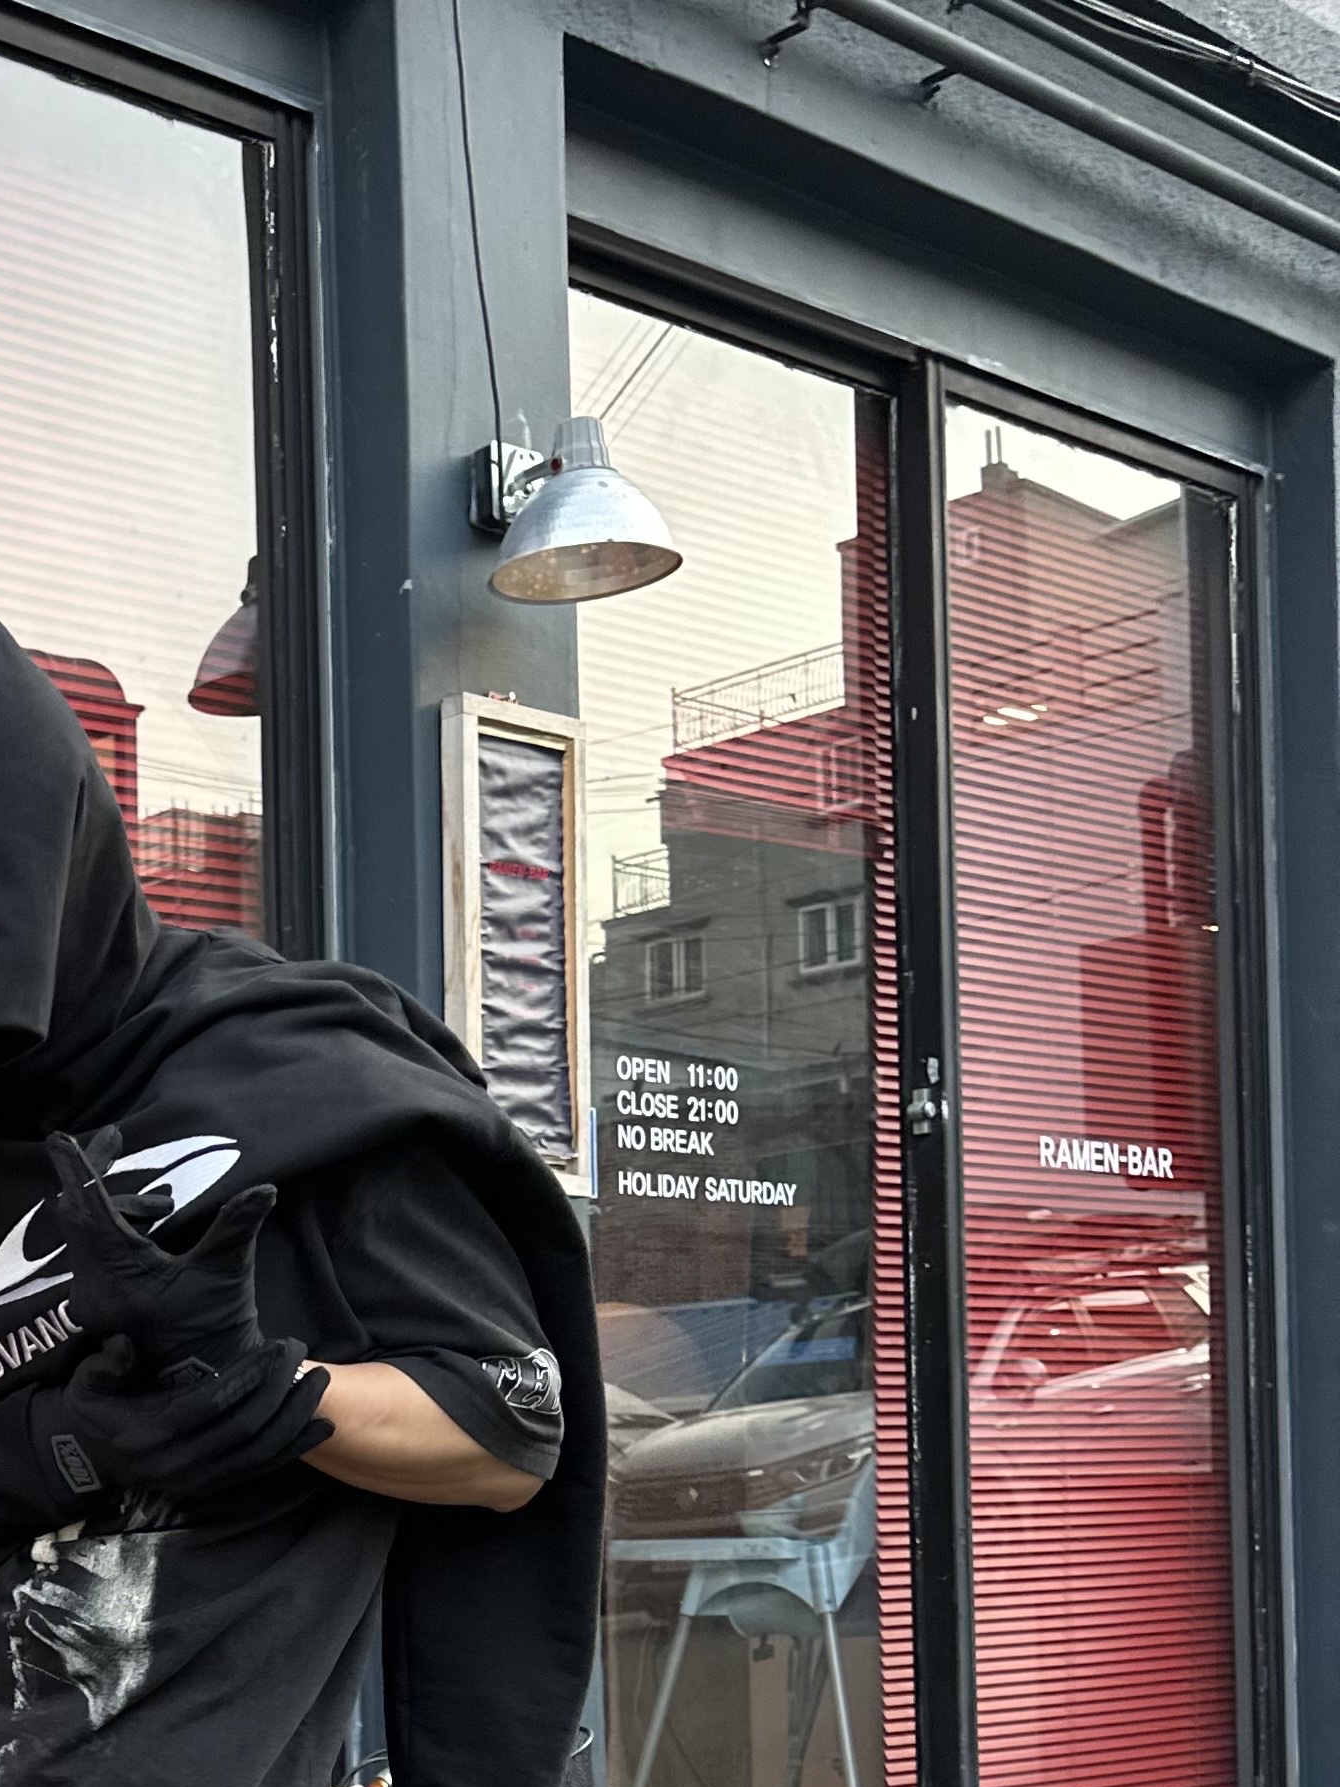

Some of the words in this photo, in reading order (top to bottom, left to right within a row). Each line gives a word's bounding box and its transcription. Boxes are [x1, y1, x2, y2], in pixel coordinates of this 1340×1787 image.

[616, 1055, 671, 1085] OPEN
[686, 1063, 739, 1092] 11:00
[616, 1089, 679, 1119] CLOSE
[686, 1096, 739, 1125] 21:00
[617, 1123, 646, 1151] NO
[650, 1127, 715, 1156] BREAK
[1039, 1135, 1174, 1179] RAMEN-BAR
[618, 1170, 700, 1200] HOLIDAY
[704, 1176, 797, 1207] SATURDAY
